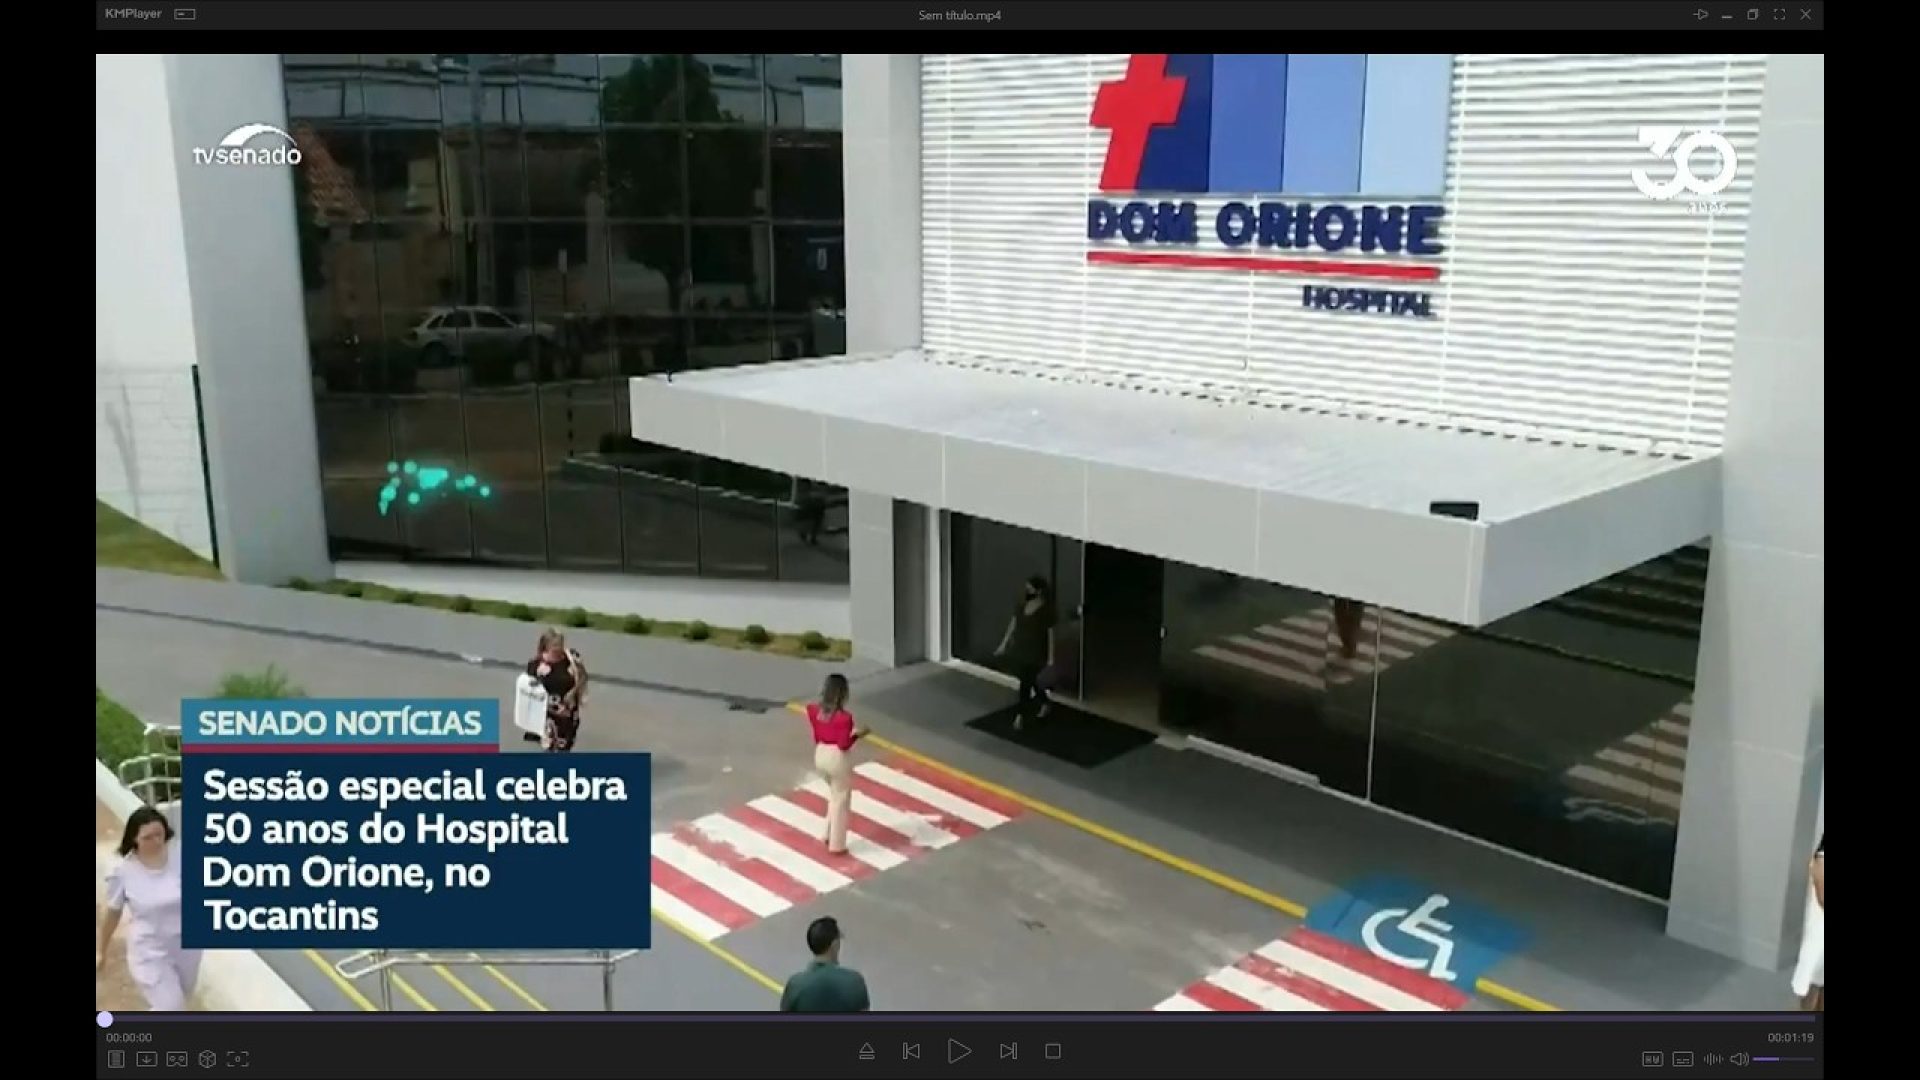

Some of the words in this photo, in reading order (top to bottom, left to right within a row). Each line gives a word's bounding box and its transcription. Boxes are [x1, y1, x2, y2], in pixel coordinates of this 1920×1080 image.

[105, 8, 162, 20] KMPlayer
[919, 9, 943, 21] Sem
[1087, 200, 1198, 243] DOM
[1216, 203, 1444, 254] ORIONE
[1302, 284, 1437, 317] HOSPITAL
[106, 1033, 153, 1043] 00:00:00
[1767, 1032, 1815, 1043] 00:01:19
